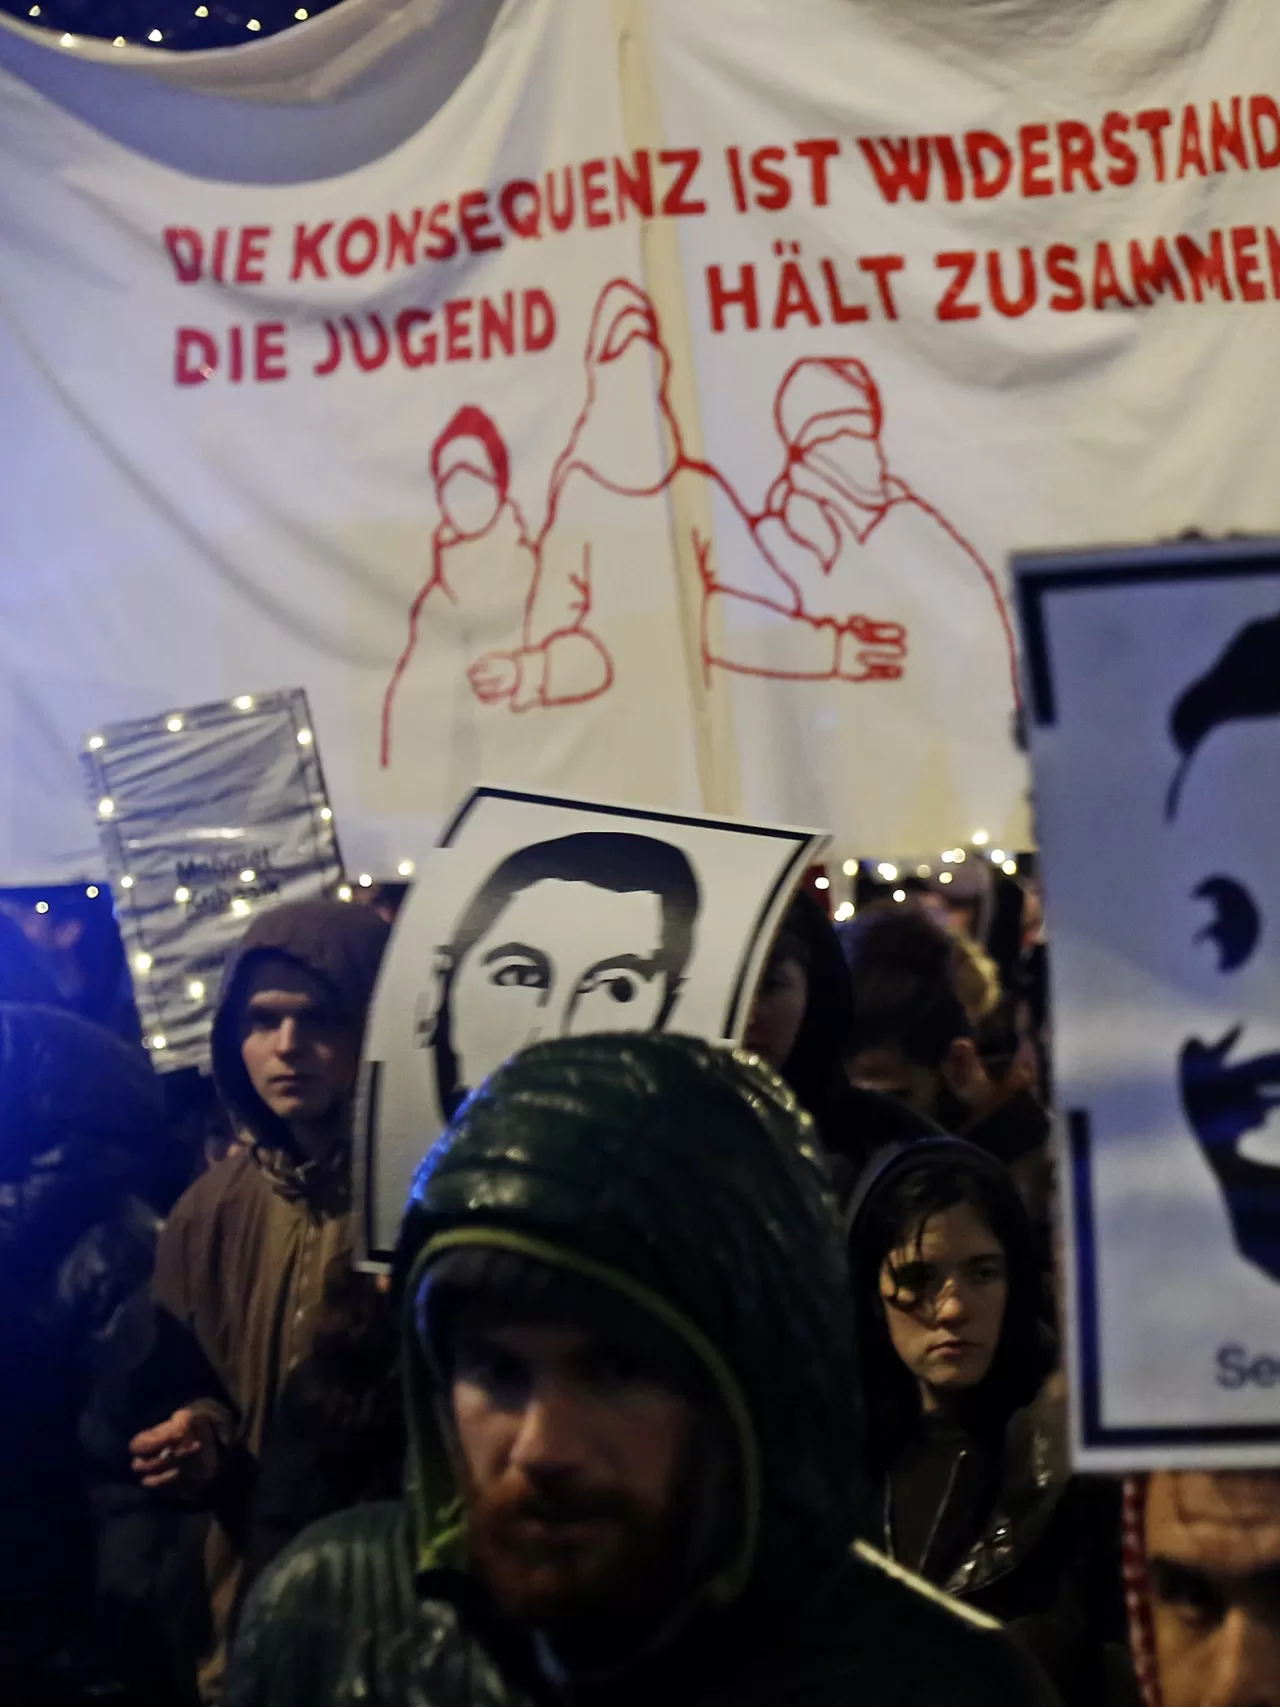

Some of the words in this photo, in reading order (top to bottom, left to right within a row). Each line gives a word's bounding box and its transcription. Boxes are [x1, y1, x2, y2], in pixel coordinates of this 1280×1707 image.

[164, 225, 271, 284] DIE
[291, 149, 707, 281] KONSEQUENZ
[726, 138, 840, 213] IST
[174, 322, 288, 386] DIE
[313, 288, 556, 377] JUGEND
[705, 241, 905, 333] HÄLT
